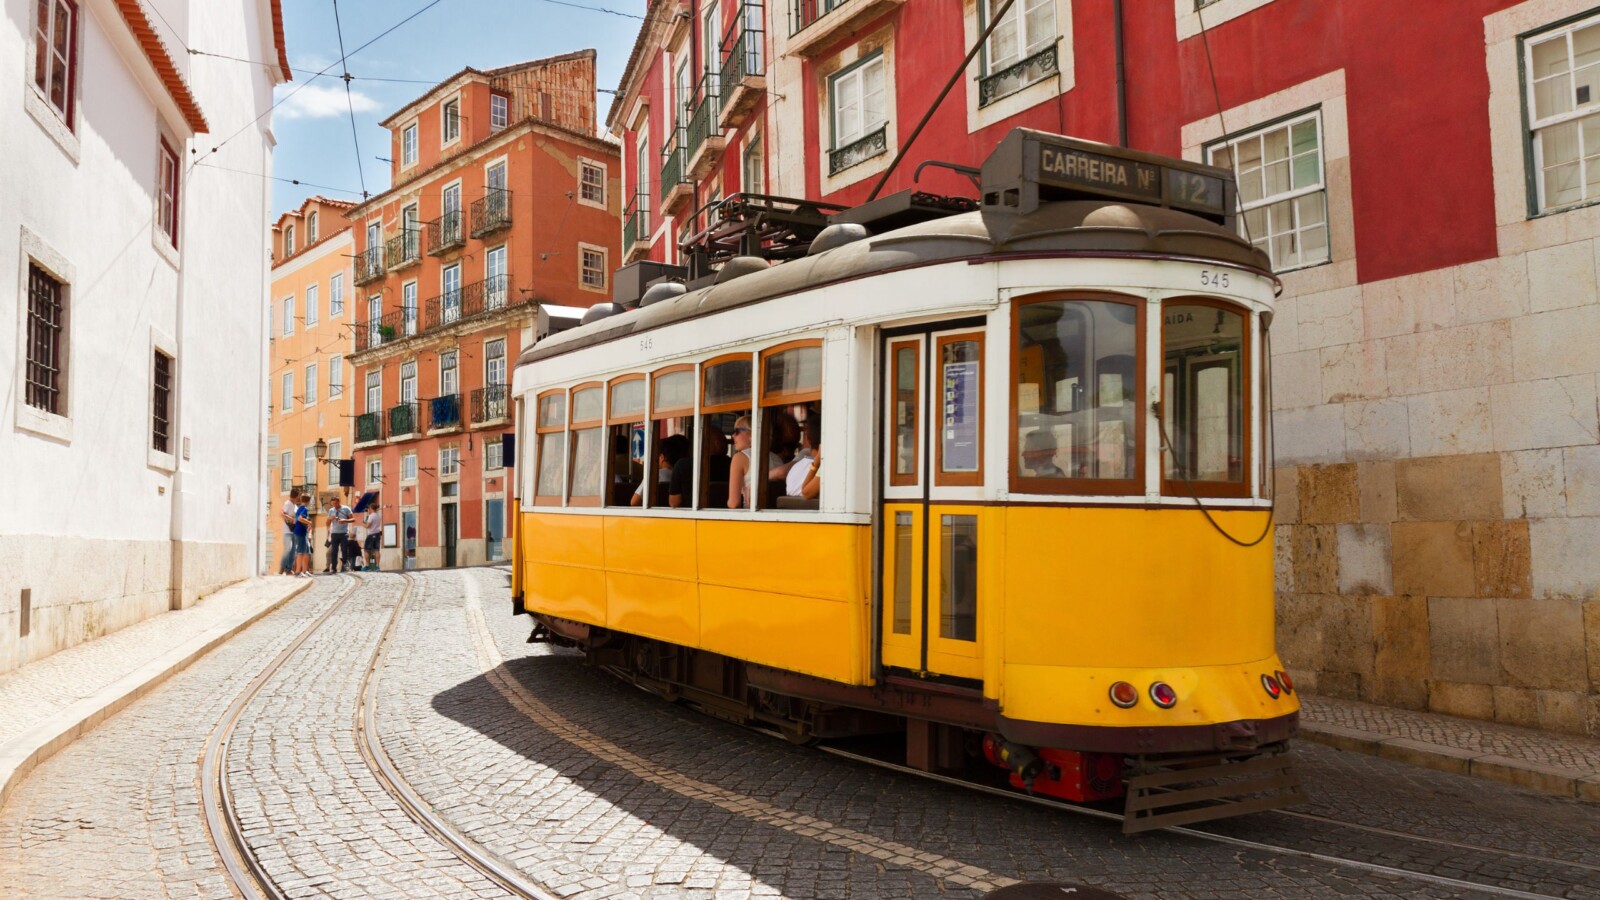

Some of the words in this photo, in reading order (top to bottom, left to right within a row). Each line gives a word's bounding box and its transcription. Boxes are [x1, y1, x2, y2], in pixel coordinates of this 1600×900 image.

[1042, 149, 1128, 186] CARREIRA
[1179, 172, 1207, 204] 12
[1201, 270, 1229, 288] 545
[640, 338, 653, 351] 545
